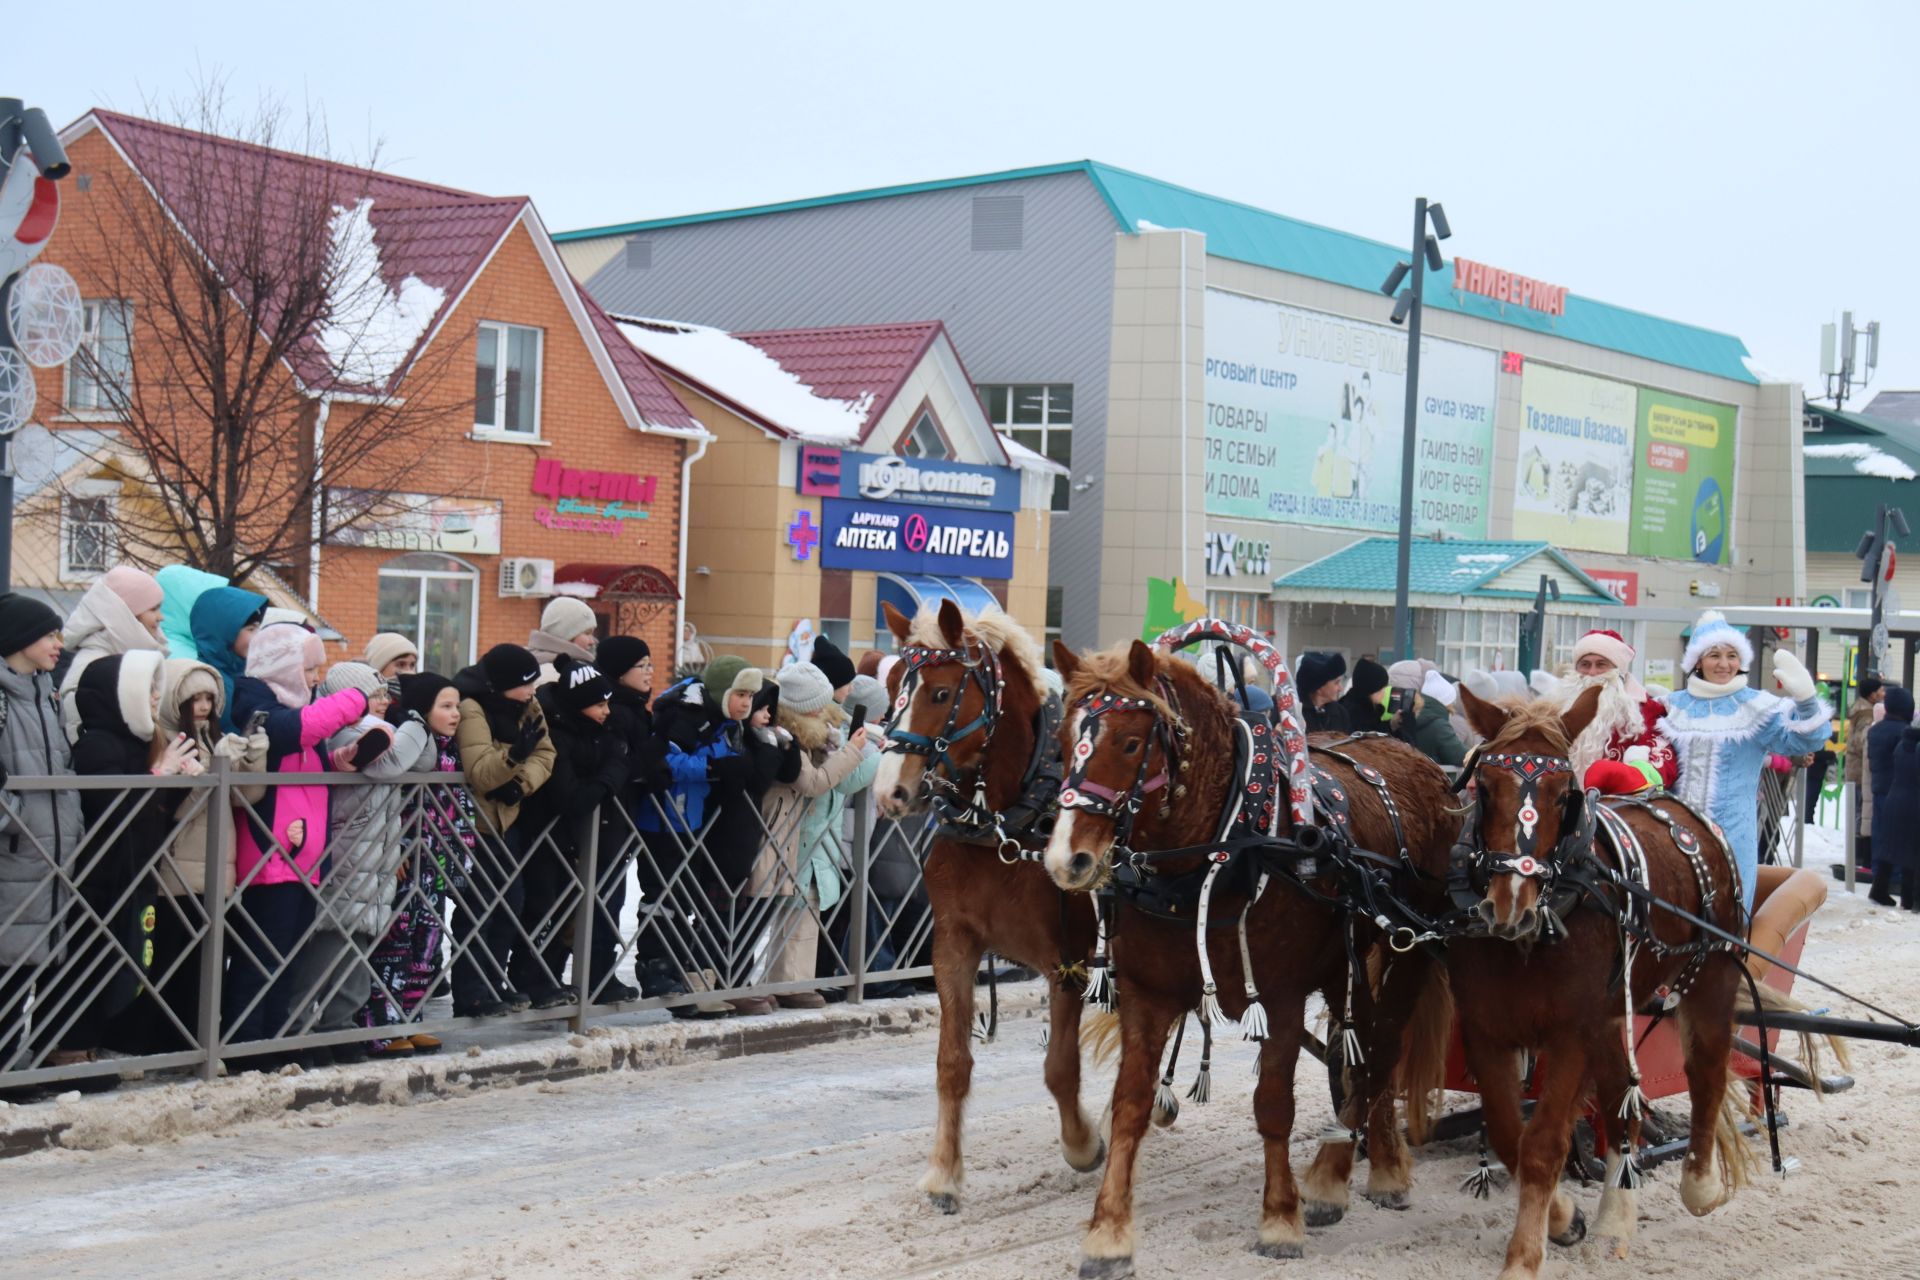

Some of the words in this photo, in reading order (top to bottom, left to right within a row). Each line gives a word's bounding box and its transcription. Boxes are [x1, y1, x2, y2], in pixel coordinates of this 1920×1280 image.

[1453, 257, 1569, 316] УНИВЕРМАГ
[1278, 311, 1428, 376] УНИВЕРМ
[1260, 368, 1297, 390] ЦЕНТР
[1207, 403, 1268, 433] ТОВАРЫ
[1584, 416, 1628, 446] базасы
[1226, 440, 1276, 467] СЕМЬИ
[533, 459, 657, 503] Цветы
[1205, 472, 1214, 493] И
[1217, 473, 1260, 499] ДОМА
[851, 511, 900, 528] ДАРУХАНӘ
[1421, 500, 1478, 525] ТОВАРЛАР
[835, 526, 897, 551] АПТЕКА
[926, 525, 1010, 559] АПРЕЛЬ
[570, 665, 602, 689] NIK
